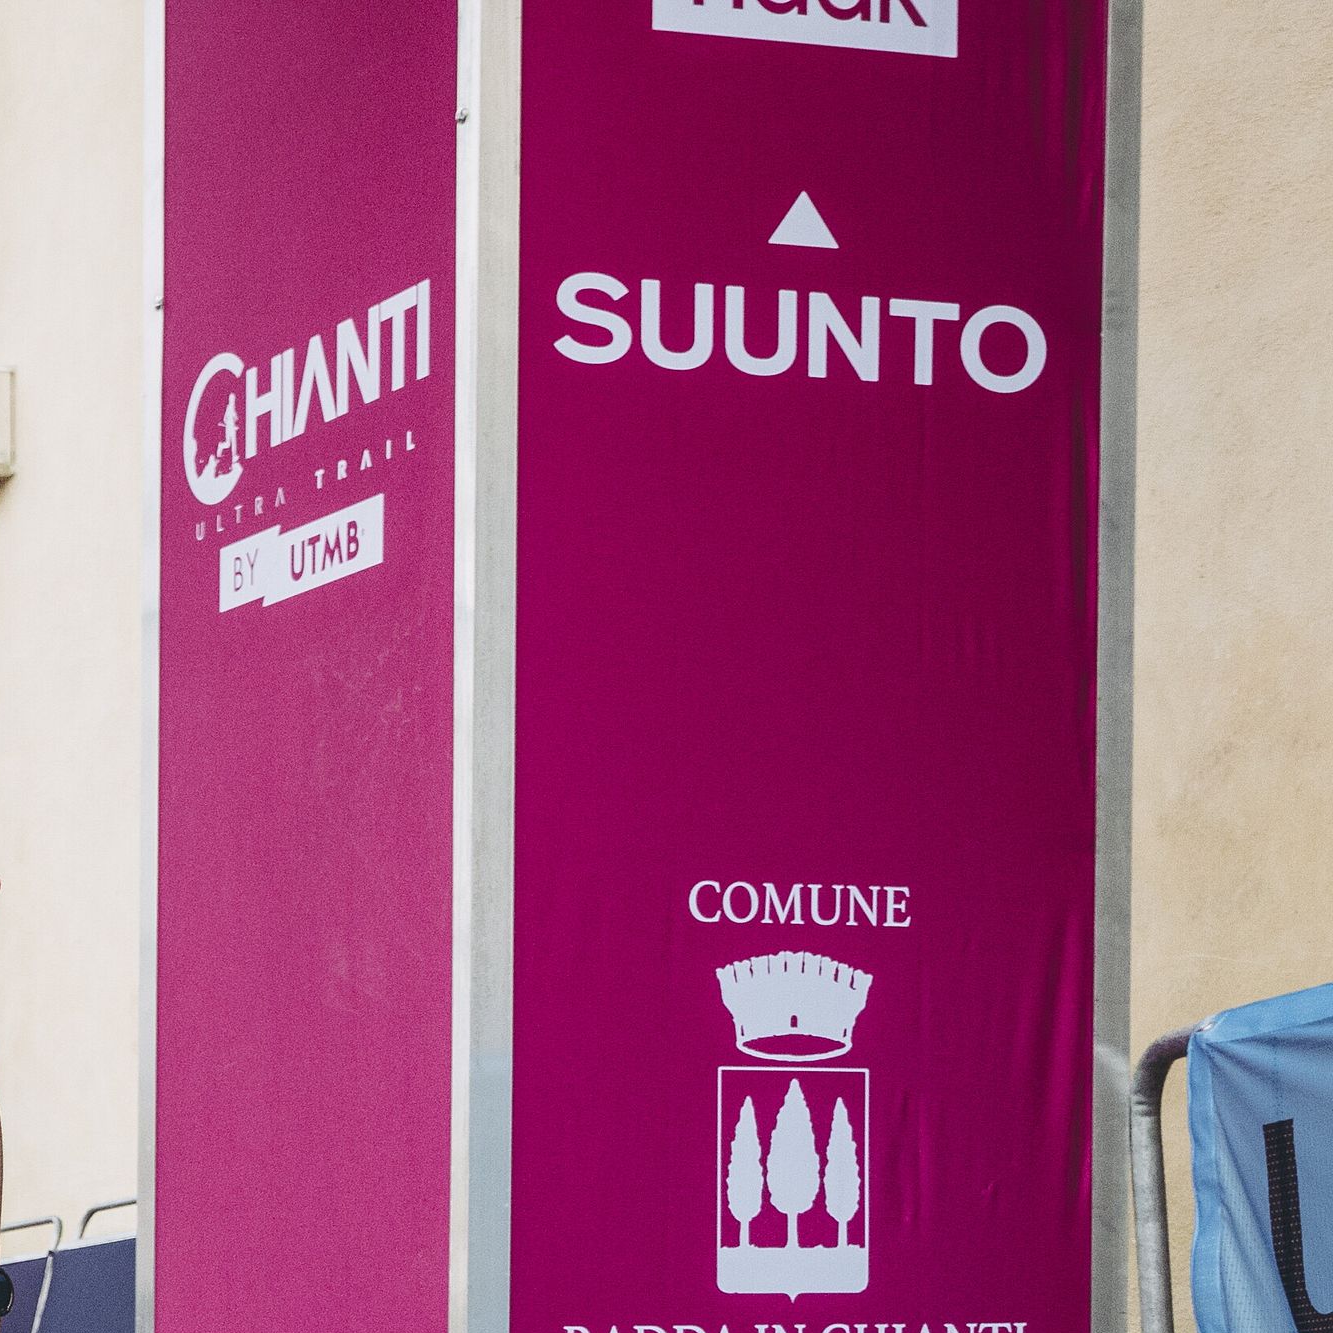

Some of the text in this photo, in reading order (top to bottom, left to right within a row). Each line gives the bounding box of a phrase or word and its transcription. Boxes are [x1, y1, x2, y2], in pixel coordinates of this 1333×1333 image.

[554, 272, 1047, 393] SUUNTO
[195, 430, 416, 541] ULTRA TRAIL
[233, 520, 360, 592] BY UTMB
[688, 880, 912, 927] COMUNE
